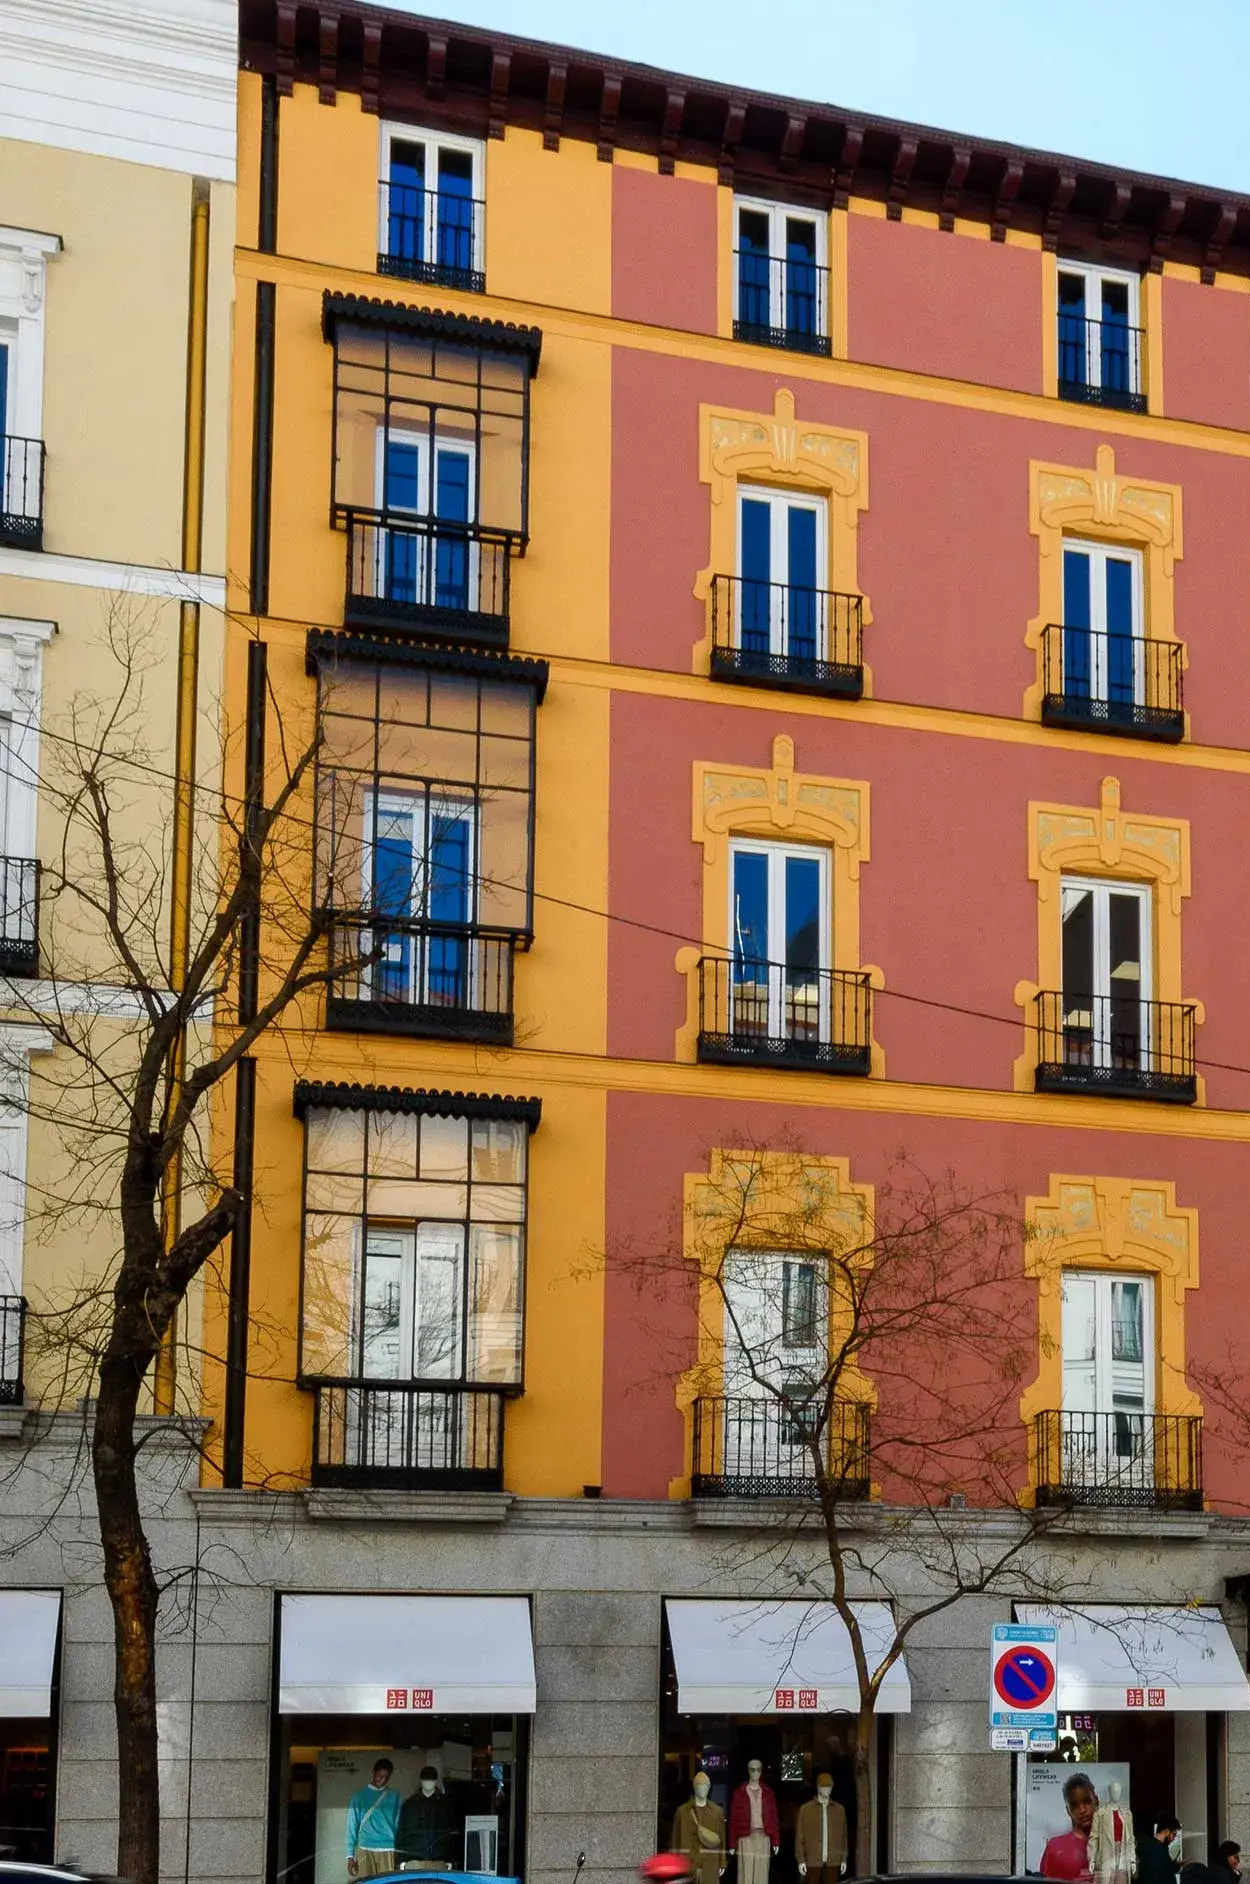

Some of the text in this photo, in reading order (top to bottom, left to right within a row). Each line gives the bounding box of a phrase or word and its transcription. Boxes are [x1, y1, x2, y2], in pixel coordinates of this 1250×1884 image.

[414, 1691, 430, 1699] UNI
[800, 1691, 815, 1699] UNI
[1149, 1690, 1163, 1698] UNI
[414, 1700, 431, 1708] QLO
